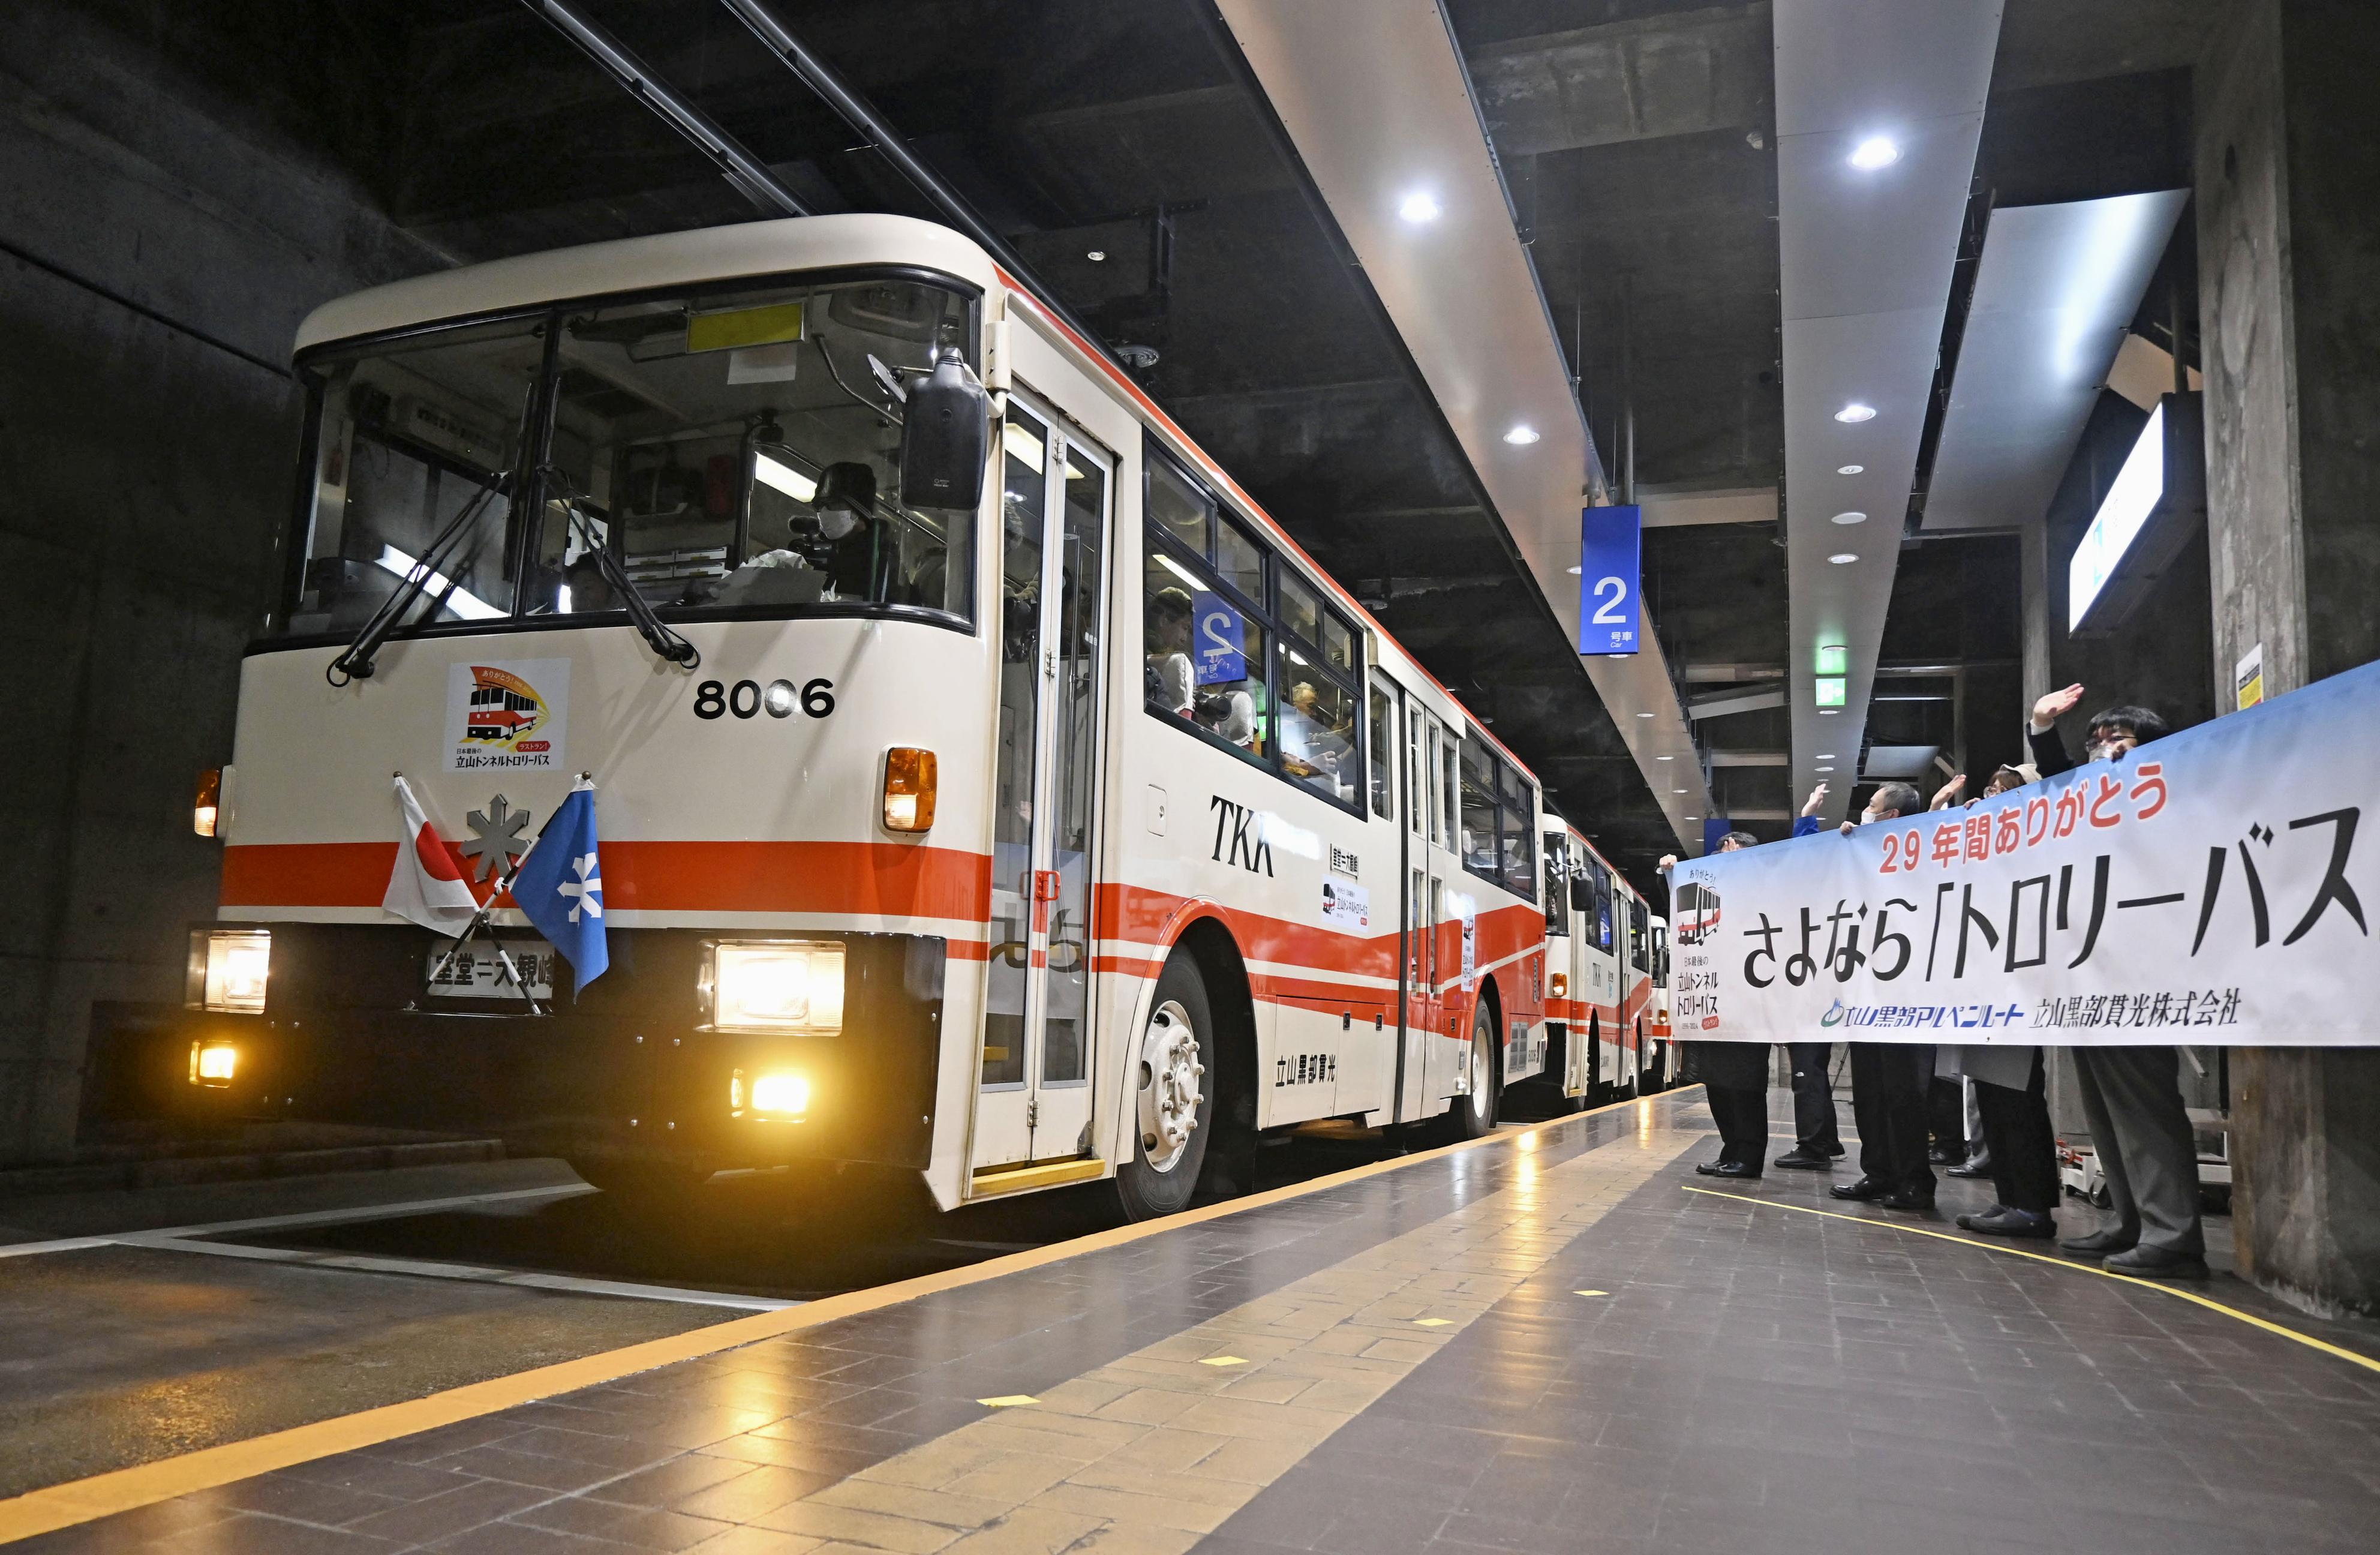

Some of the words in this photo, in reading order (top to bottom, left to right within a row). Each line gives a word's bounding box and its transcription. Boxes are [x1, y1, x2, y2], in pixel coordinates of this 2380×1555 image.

[1592, 577, 1627, 624] 2
[1610, 631, 1633, 642] 号車
[482, 670, 514, 684] ありがとう!
[693, 678, 836, 719] 8006
[455, 754, 550, 769] 立山トンネルトロリーバス
[1689, 868, 1716, 885] ありがとう!
[1684, 956, 1708, 966] 日本最後の
[1678, 972, 1718, 992] 立山トンネル
[1678, 993, 1717, 1017] トロリーバス
[2029, 987, 2241, 1028] 立山黒部貫光株式会社
[1275, 1054, 1336, 1087] 立山黒部貫光
